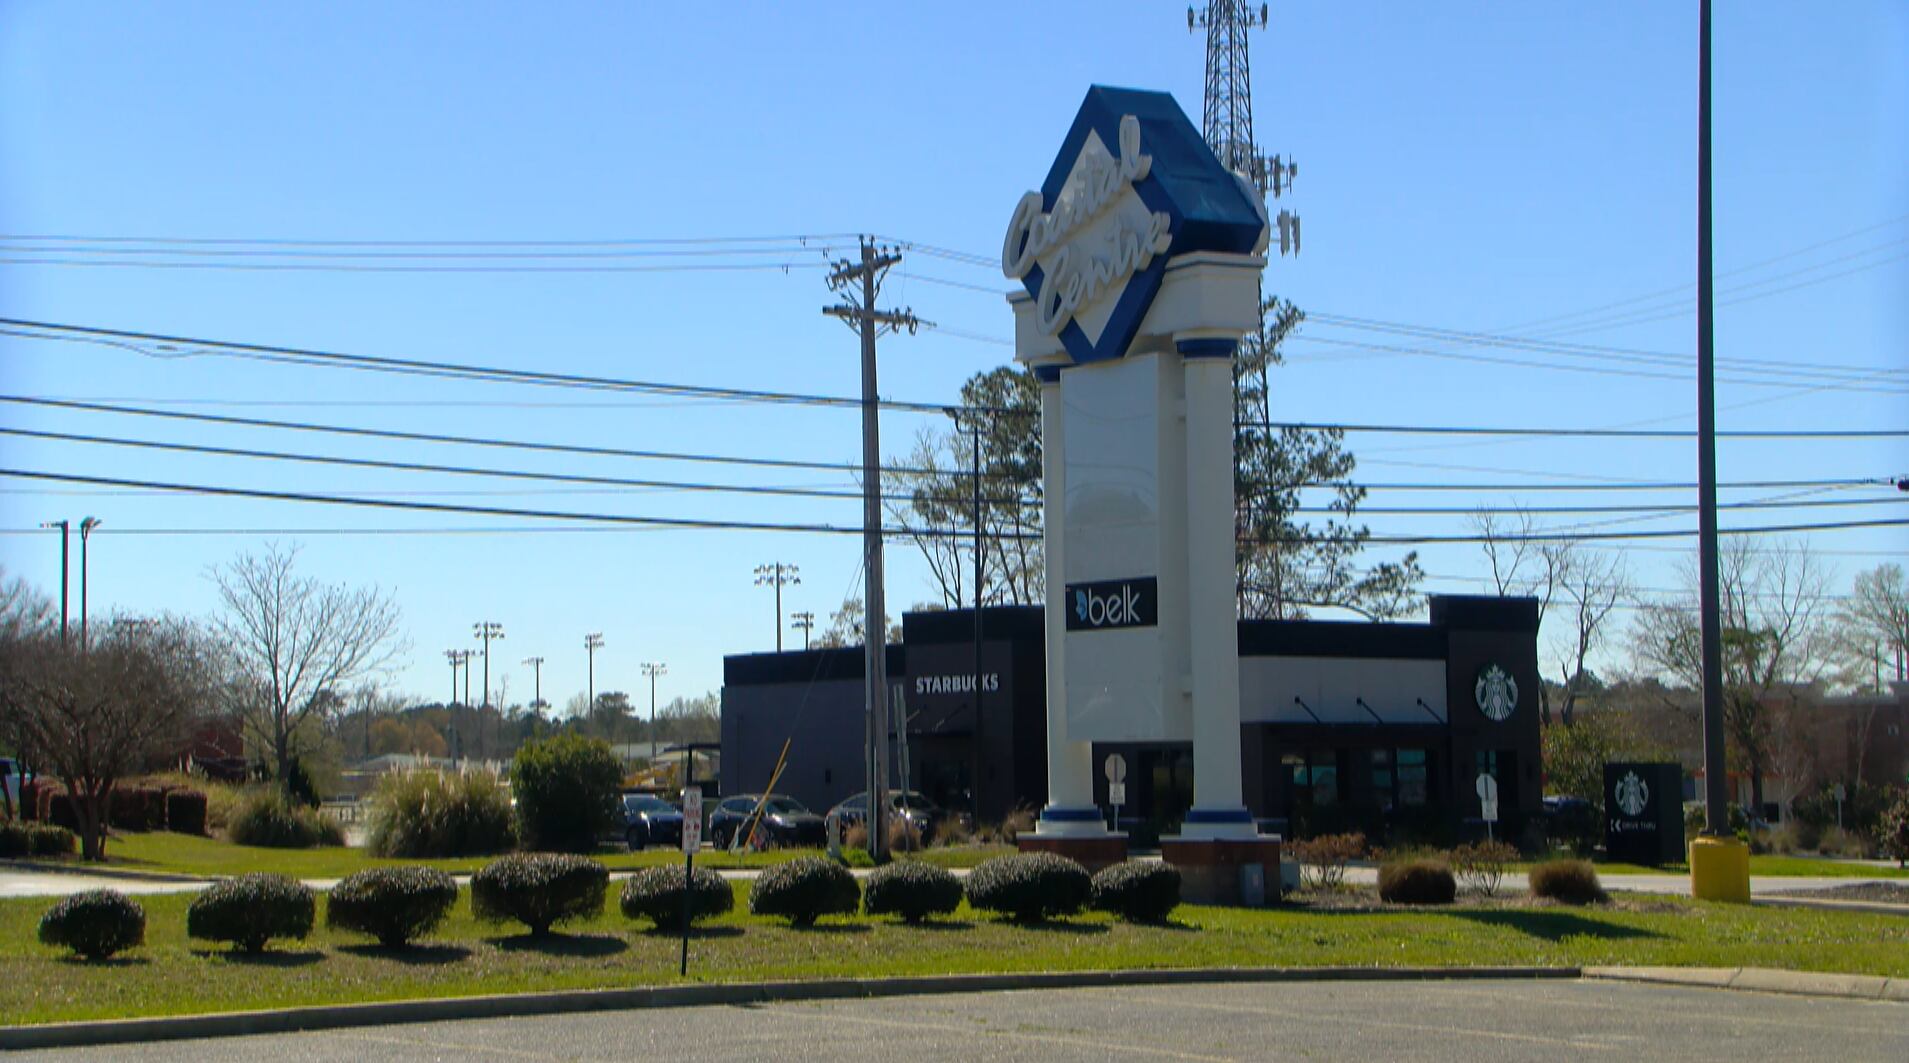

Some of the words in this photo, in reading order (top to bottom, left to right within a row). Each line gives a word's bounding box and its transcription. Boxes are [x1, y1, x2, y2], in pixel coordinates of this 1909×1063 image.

[1001, 113, 1153, 279] Coastal
[1035, 211, 1173, 337] Centre
[1088, 584, 1141, 626] belk
